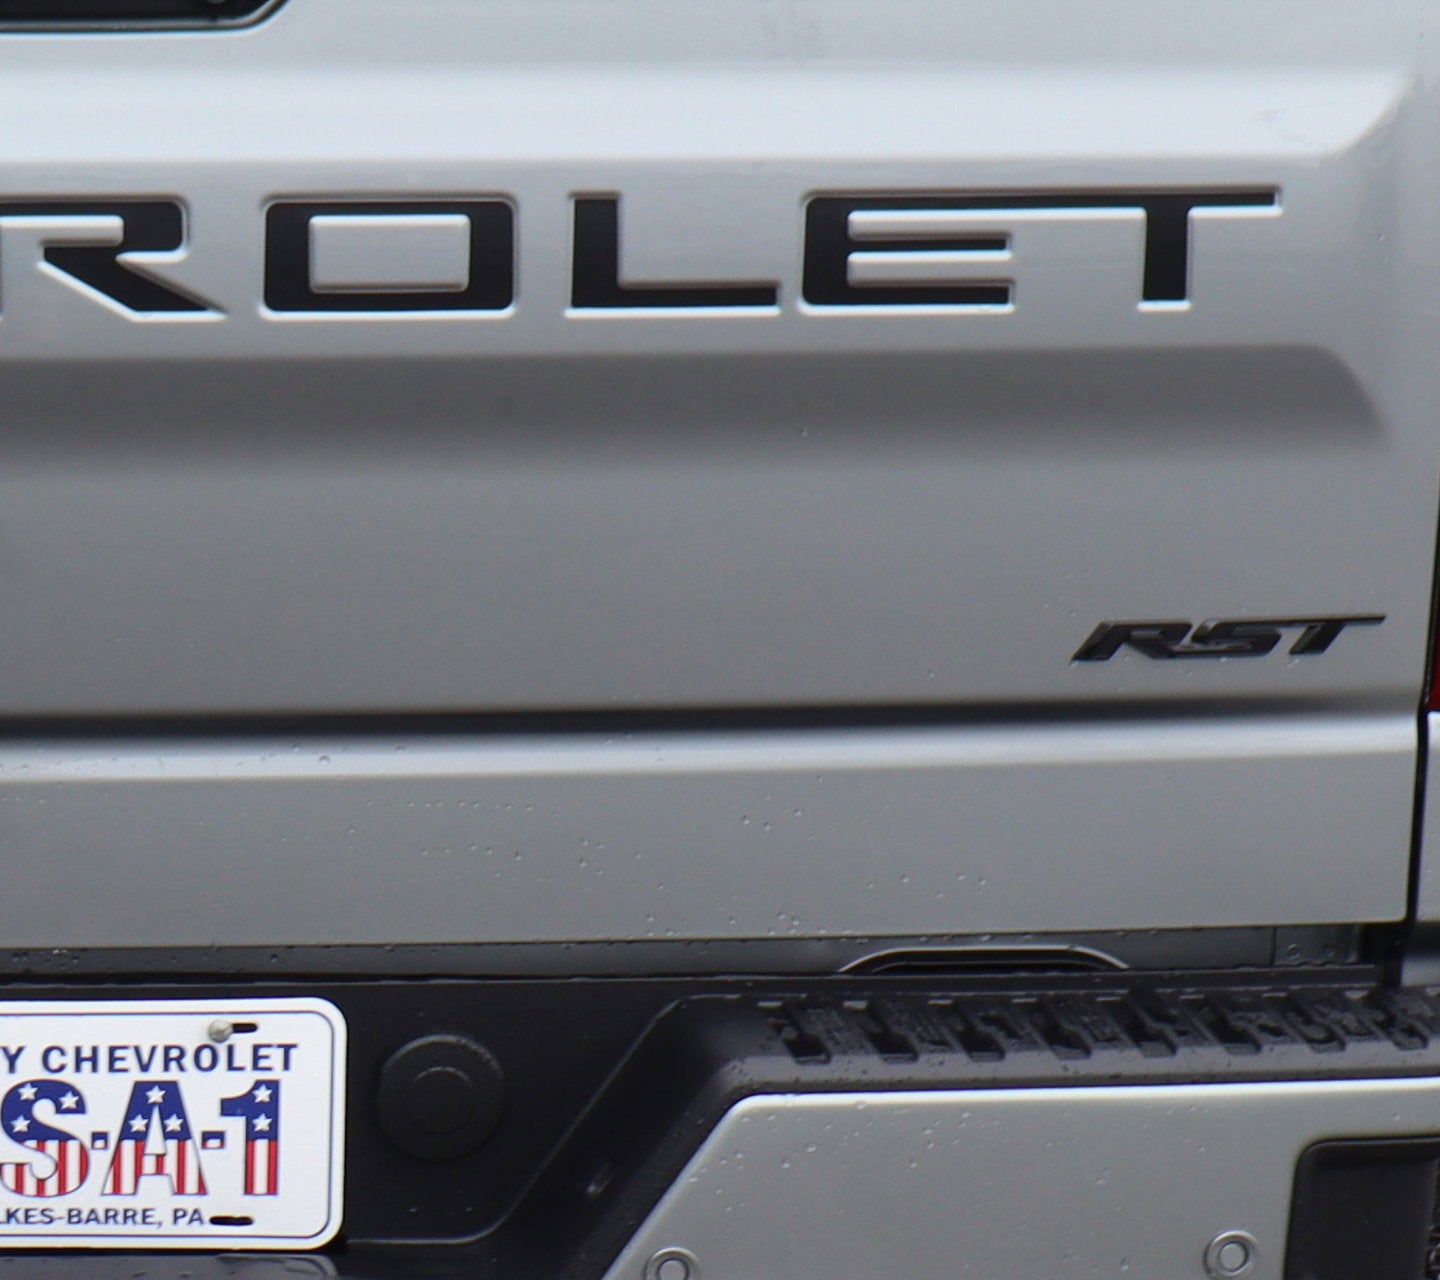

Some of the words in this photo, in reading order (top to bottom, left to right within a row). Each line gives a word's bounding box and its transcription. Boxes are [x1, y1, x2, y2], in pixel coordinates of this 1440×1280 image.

[1070, 615, 1387, 662] RST
[41, 1042, 300, 1073] CHEVROLET
[172, 1207, 205, 1225] PA
